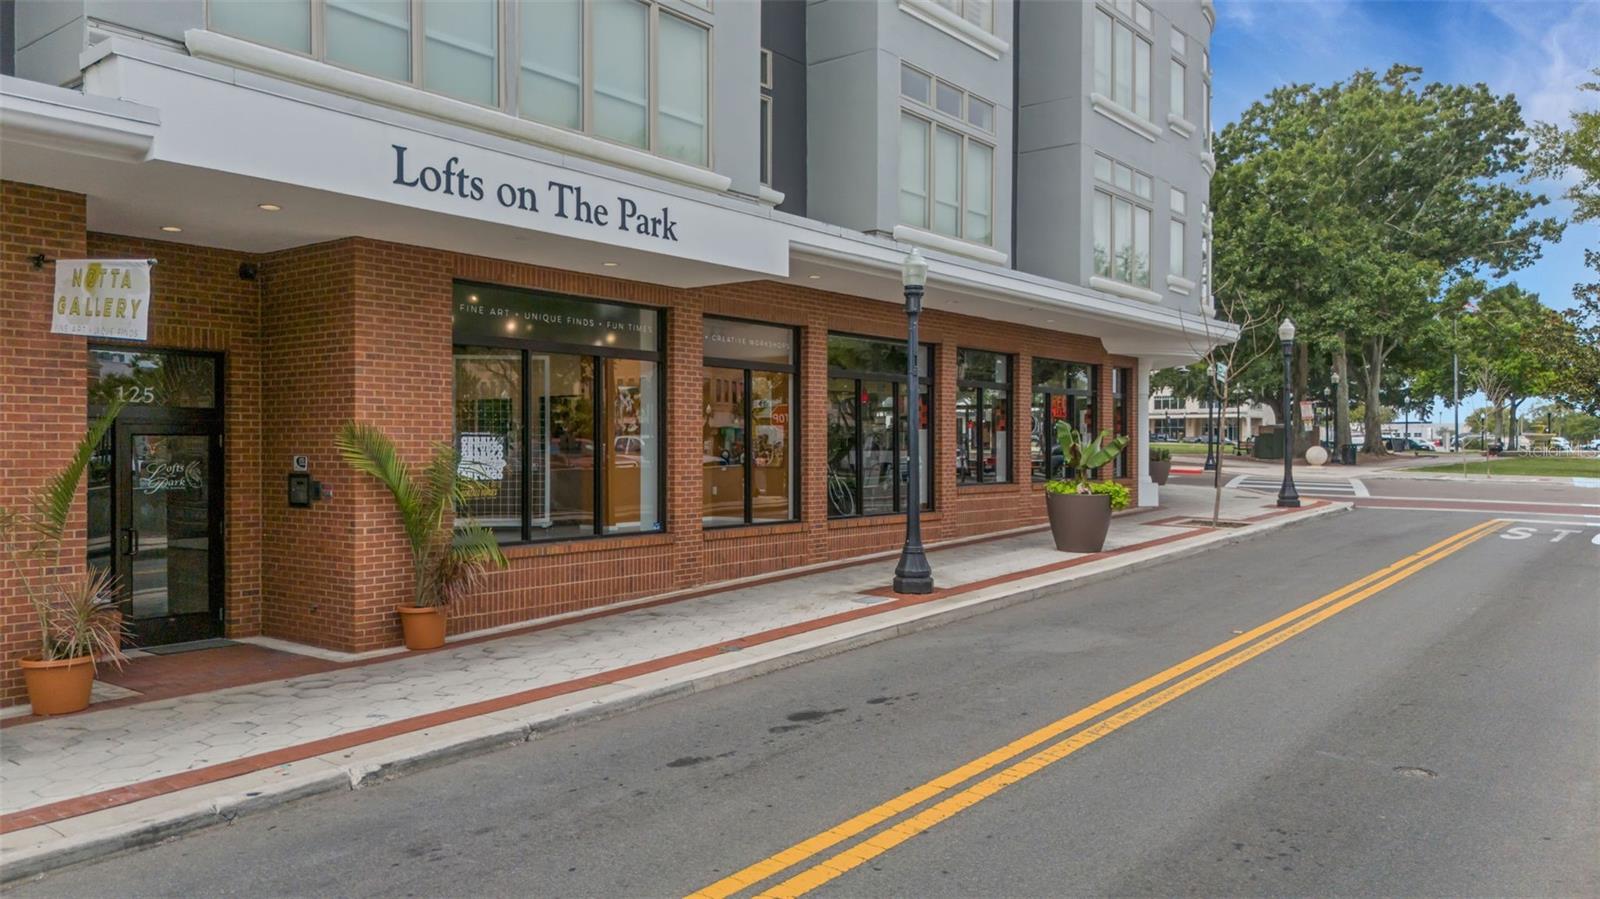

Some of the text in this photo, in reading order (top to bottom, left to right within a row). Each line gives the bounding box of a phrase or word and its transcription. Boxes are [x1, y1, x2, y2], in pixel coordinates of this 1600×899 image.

[391, 144, 679, 242] Lofts on The Park
[57, 295, 142, 319] GALLERY
[459, 303, 654, 334] FINE ART UNIQUE FINDS FUN TIMES
[711, 334, 791, 351] CREATIVE WORKSHOPS
[116, 386, 155, 404] 125
[146, 463, 185, 481] Lofts
[143, 477, 186, 495] Park
